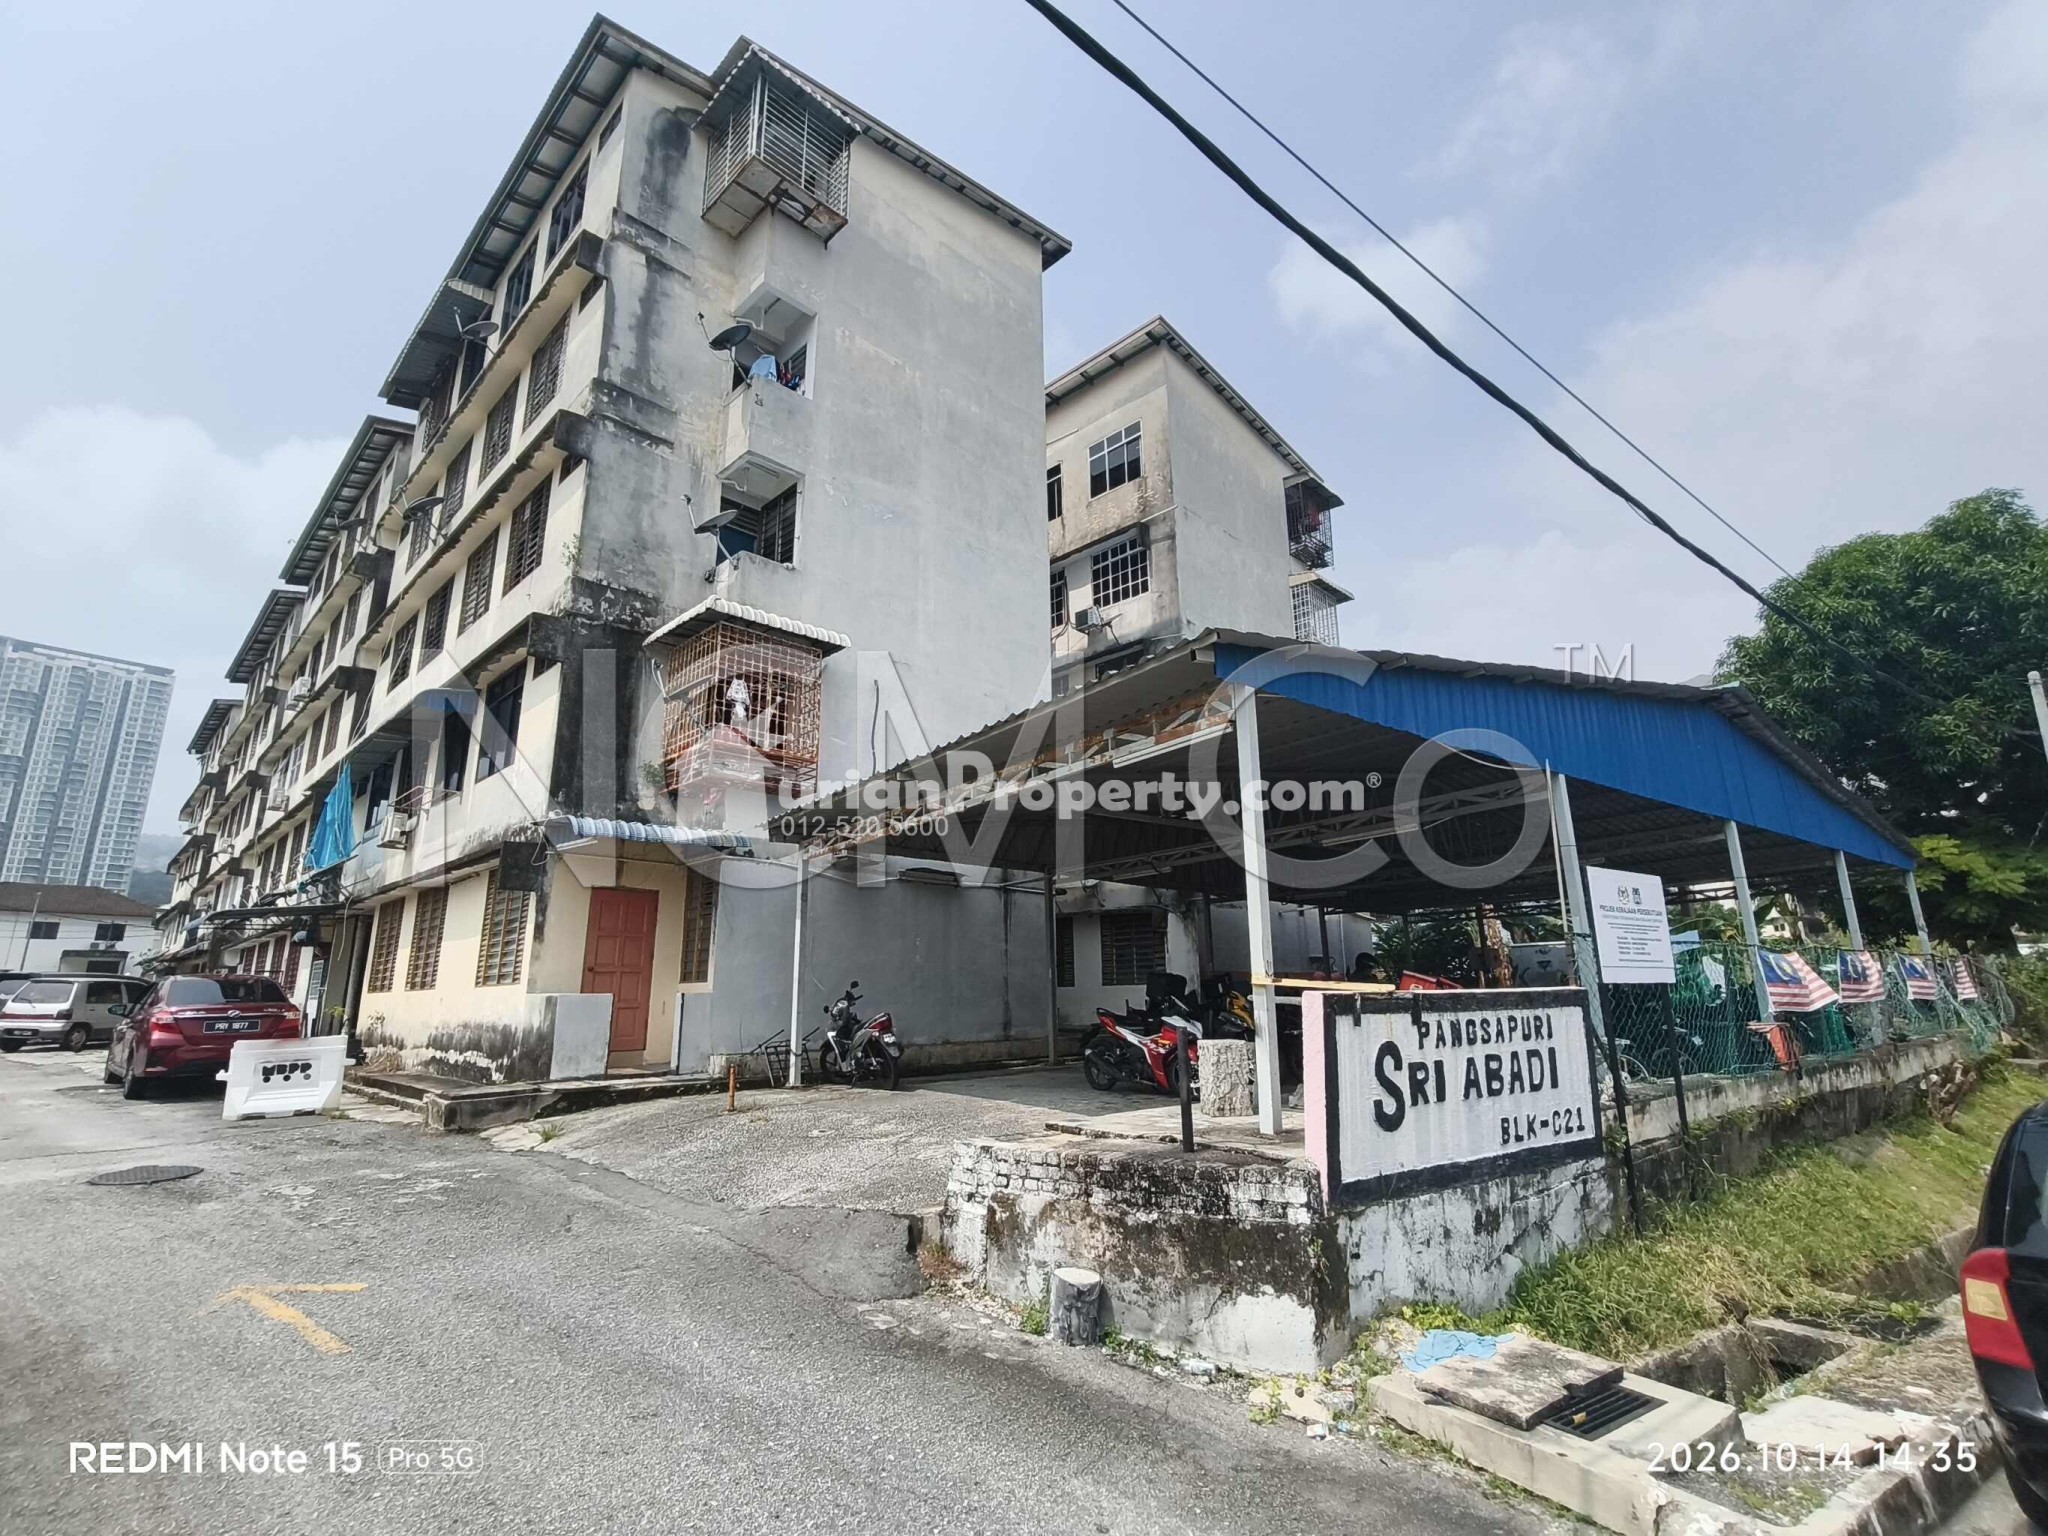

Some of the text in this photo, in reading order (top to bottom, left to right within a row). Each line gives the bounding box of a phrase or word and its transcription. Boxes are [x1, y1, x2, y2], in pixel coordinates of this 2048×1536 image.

[1417, 1013, 1554, 1050] PANGSAPURI
[1373, 1040, 1559, 1133] SRI ABADI
[1500, 1106, 1586, 1146] BLK-C21
